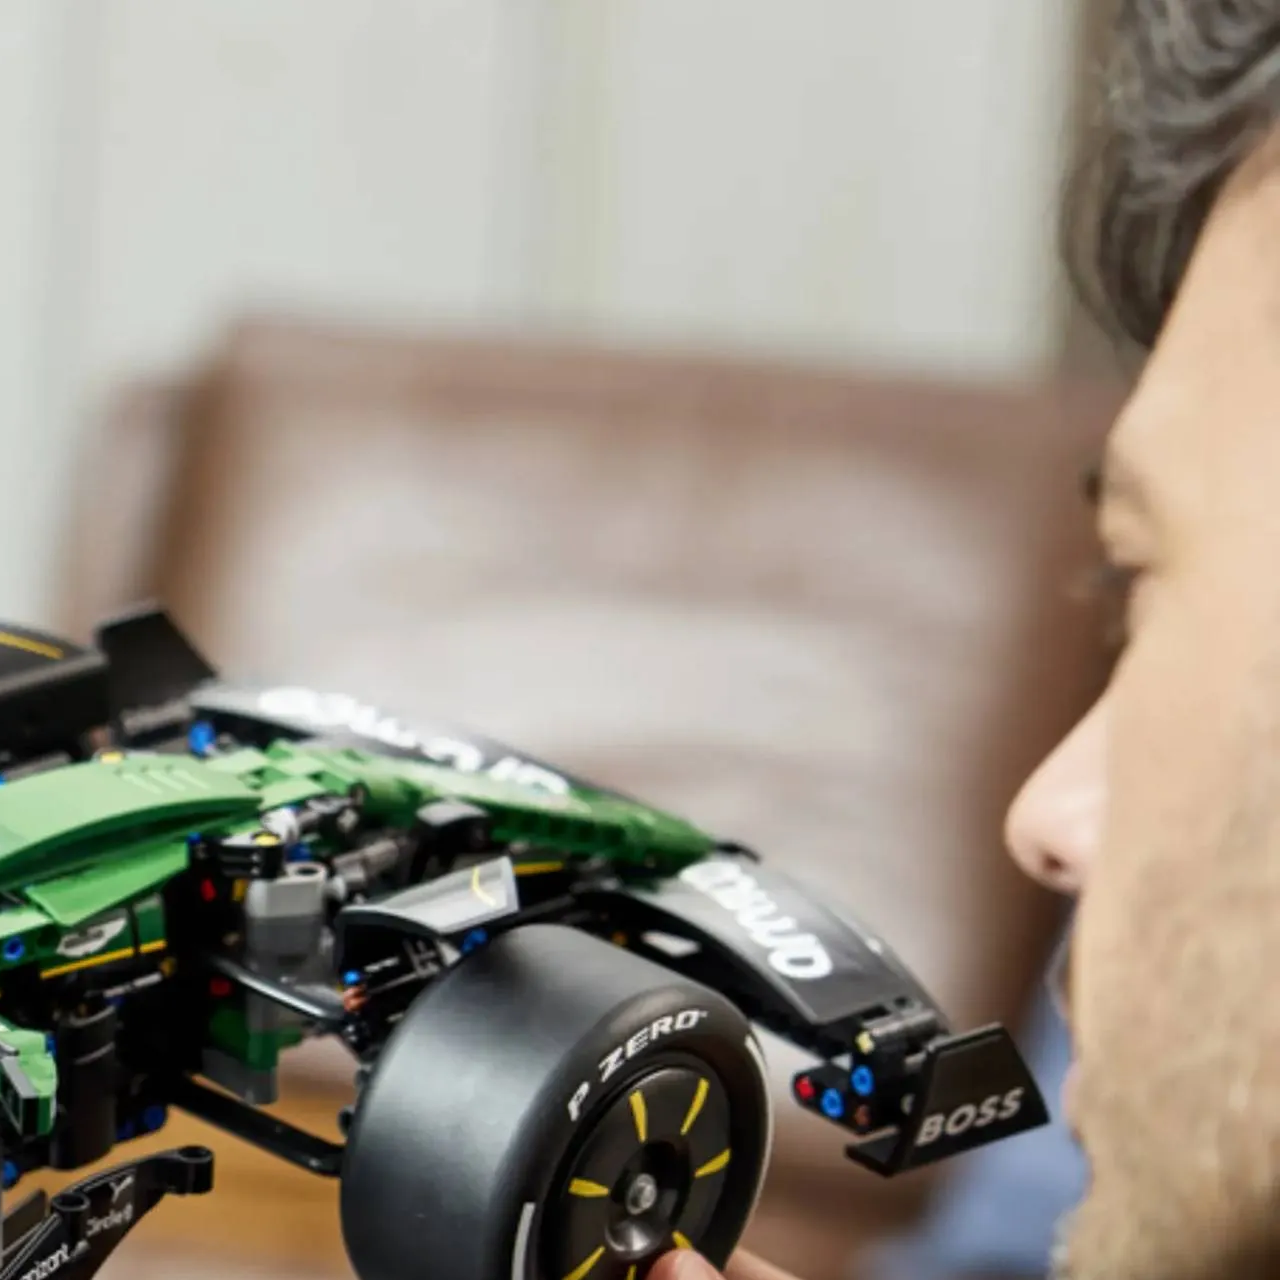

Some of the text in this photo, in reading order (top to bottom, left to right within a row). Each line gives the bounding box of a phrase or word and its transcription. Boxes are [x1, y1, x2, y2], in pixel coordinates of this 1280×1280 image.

[567, 1009, 700, 1122] P ZERO
[915, 1087, 1024, 1146] BOSS
